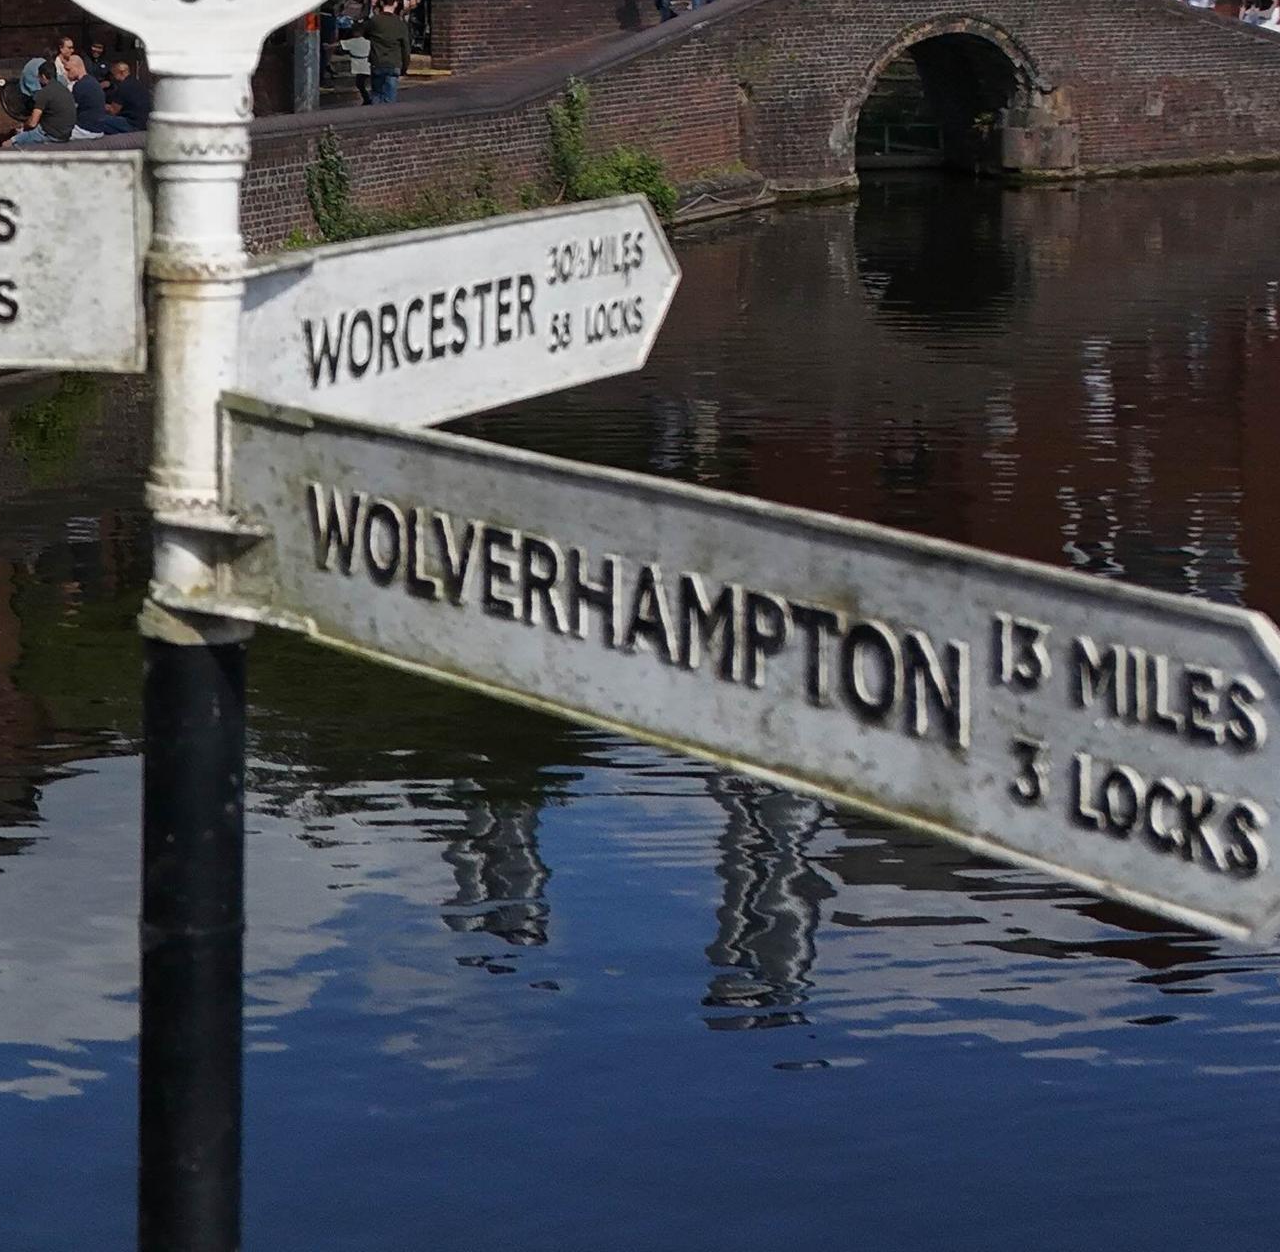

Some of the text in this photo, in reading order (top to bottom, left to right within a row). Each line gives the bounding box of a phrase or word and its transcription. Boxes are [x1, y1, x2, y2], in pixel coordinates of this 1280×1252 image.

[588, 230, 644, 279] MILES
[302, 273, 536, 389] WORCESTER
[548, 296, 643, 354] 58 LOCKS
[306, 482, 971, 749] WOLVERHAMPTON
[995, 610, 1267, 757] 13 MILES
[1012, 734, 1271, 882] 3 LOCKS
